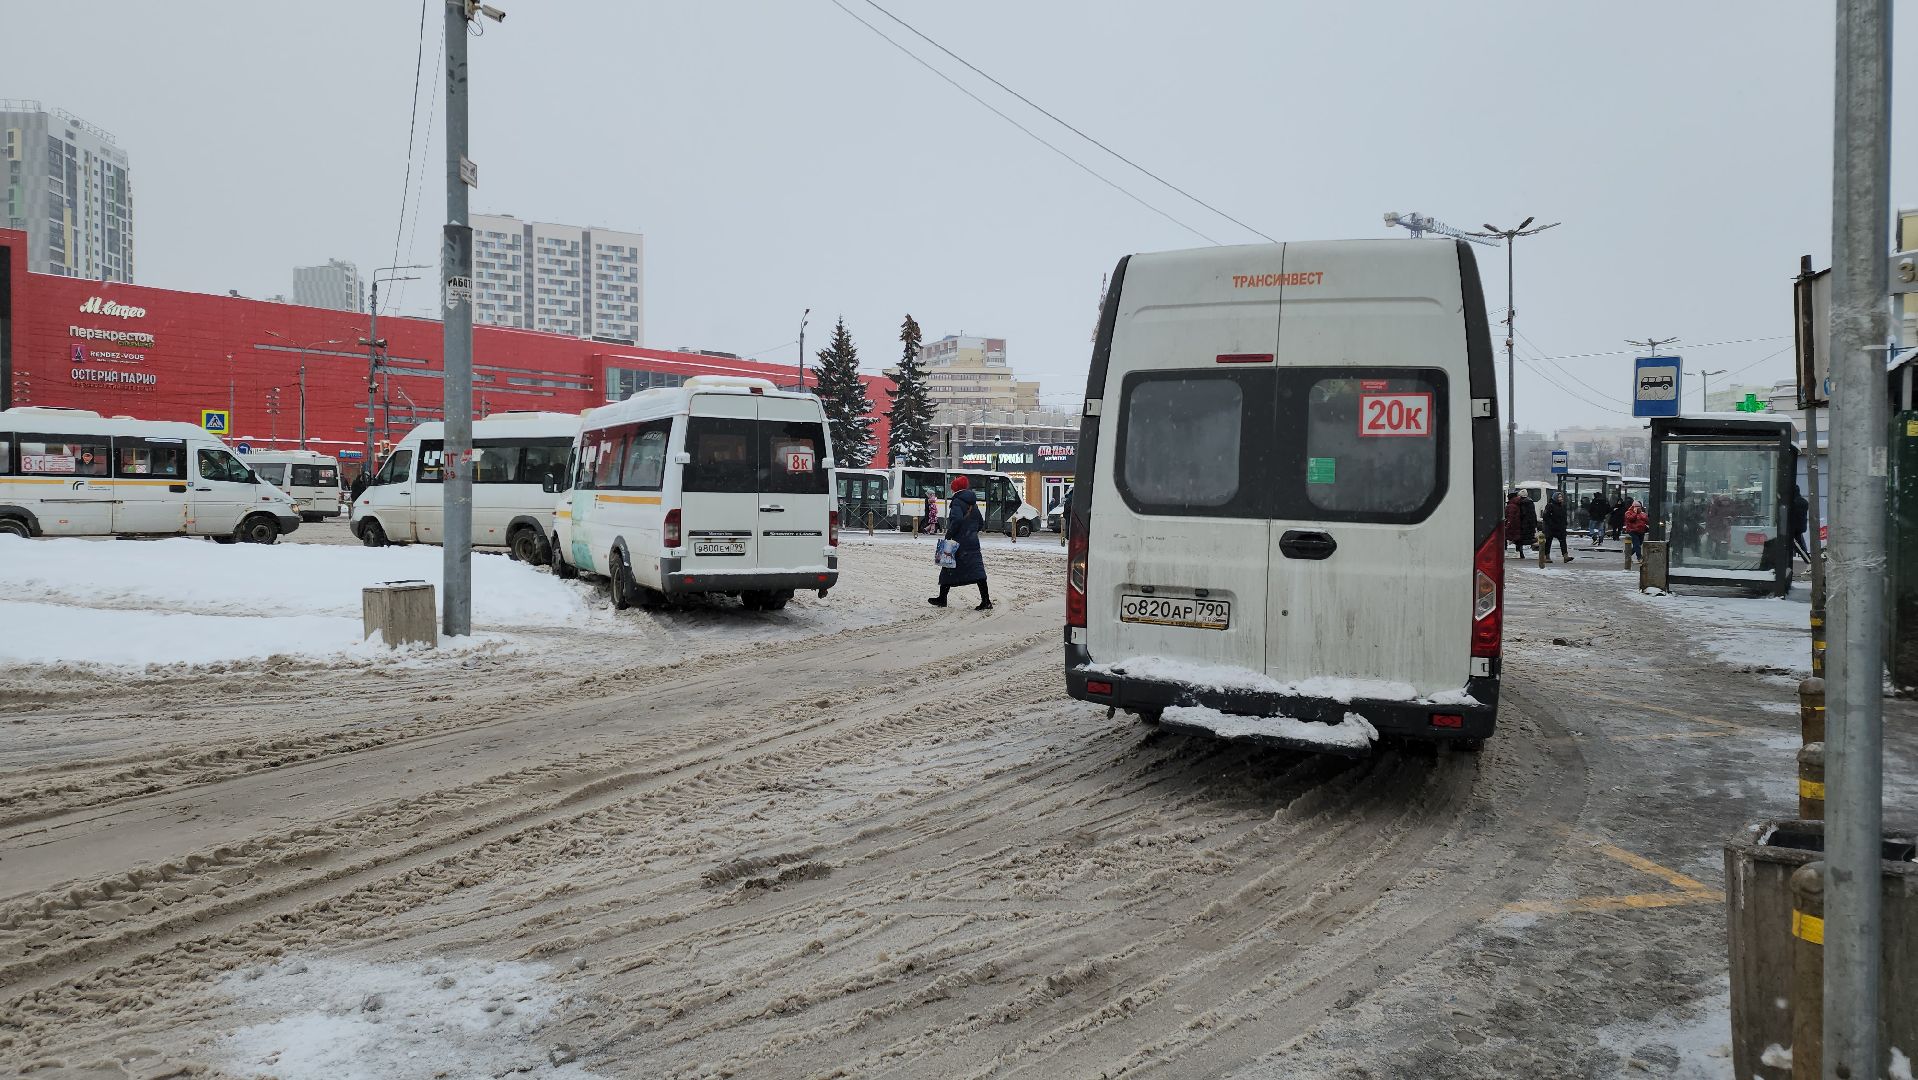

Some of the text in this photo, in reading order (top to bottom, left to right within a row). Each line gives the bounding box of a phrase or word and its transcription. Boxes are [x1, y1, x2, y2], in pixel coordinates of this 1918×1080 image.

[1232, 271, 1324, 288] ТРАНСИНВЕСТ
[90, 350, 145, 361] RENDEZ-VOUS
[71, 368, 157, 385] ОСТЕРИЯ МАРИО
[1127, 600, 1224, 619] О820АР 790
